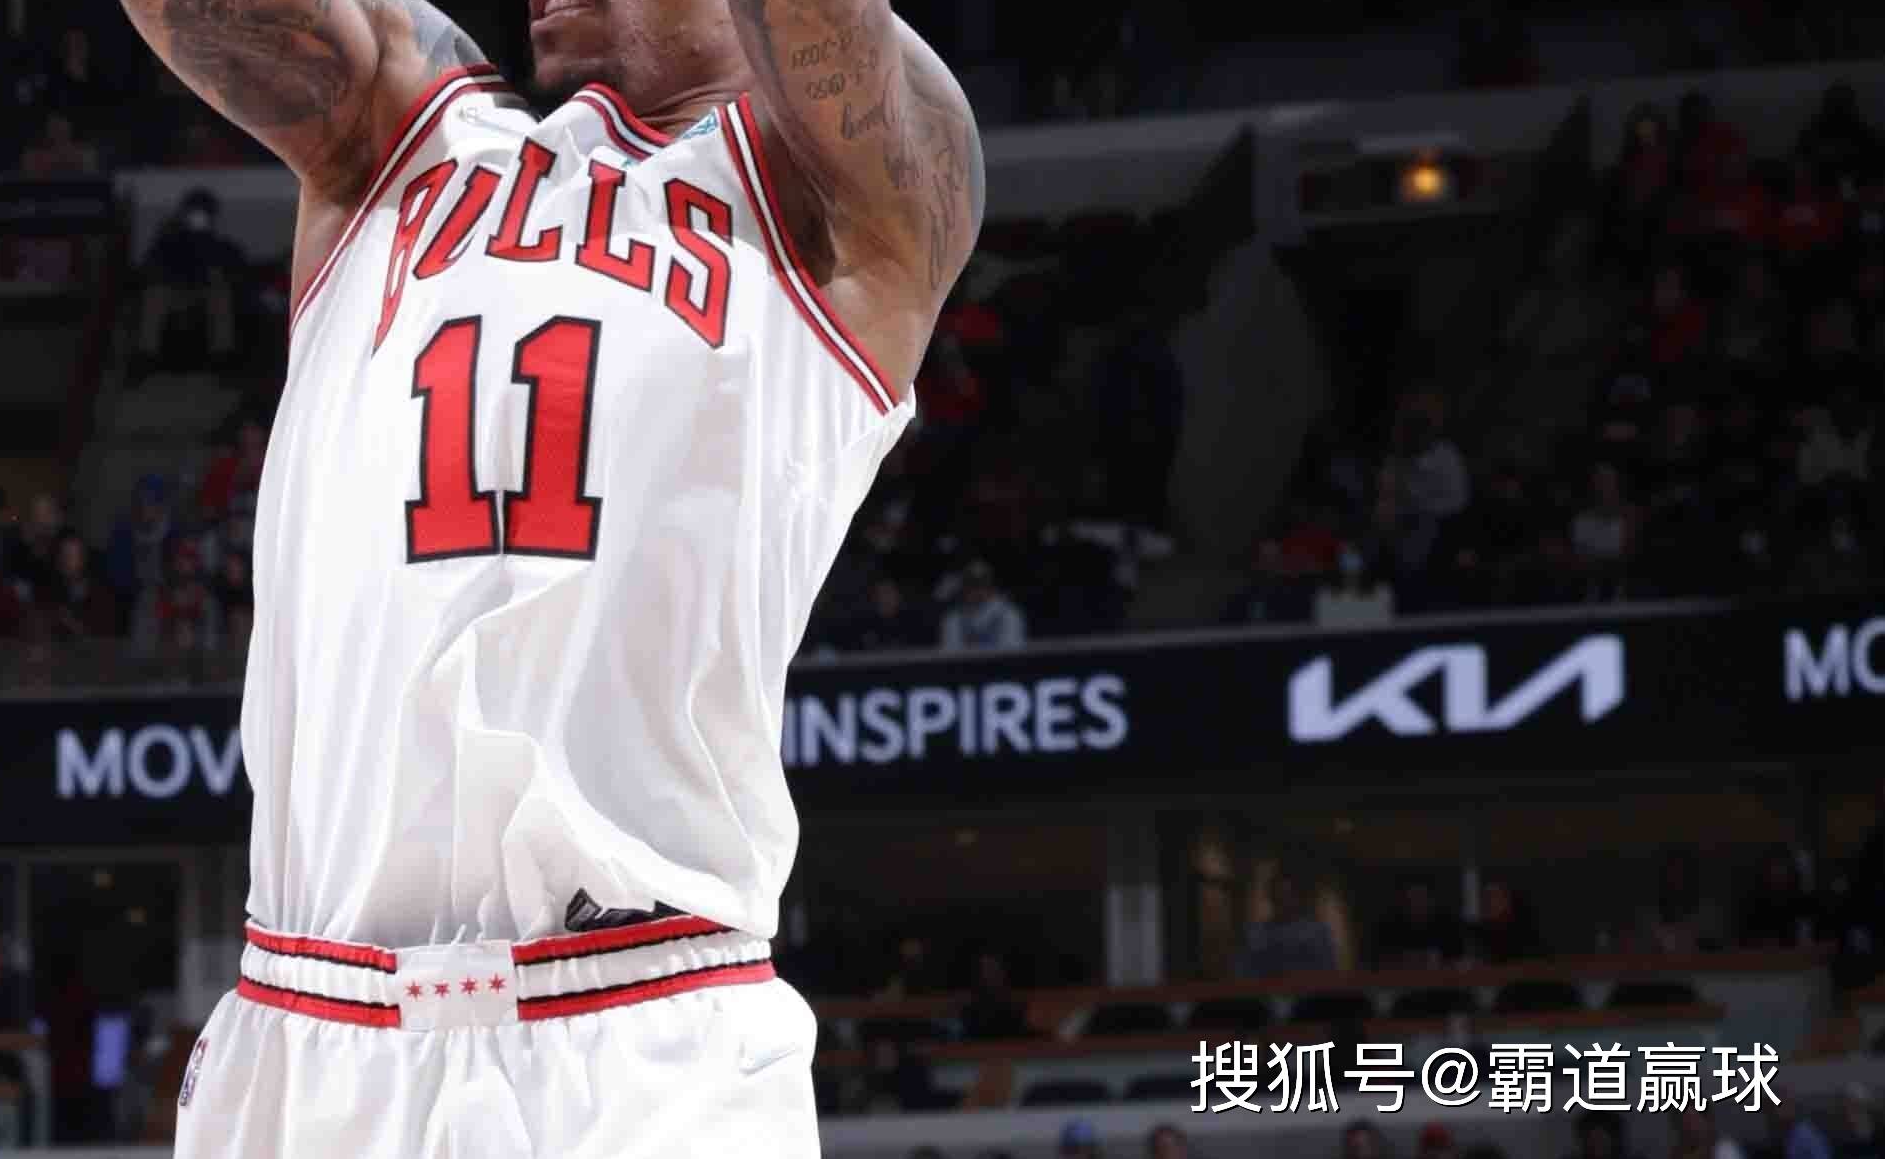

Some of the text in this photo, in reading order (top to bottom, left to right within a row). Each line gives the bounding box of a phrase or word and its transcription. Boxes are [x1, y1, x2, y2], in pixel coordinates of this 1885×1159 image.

[371, 136, 734, 360] BULLS
[404, 314, 603, 563] 11
[55, 724, 242, 799] MOV
